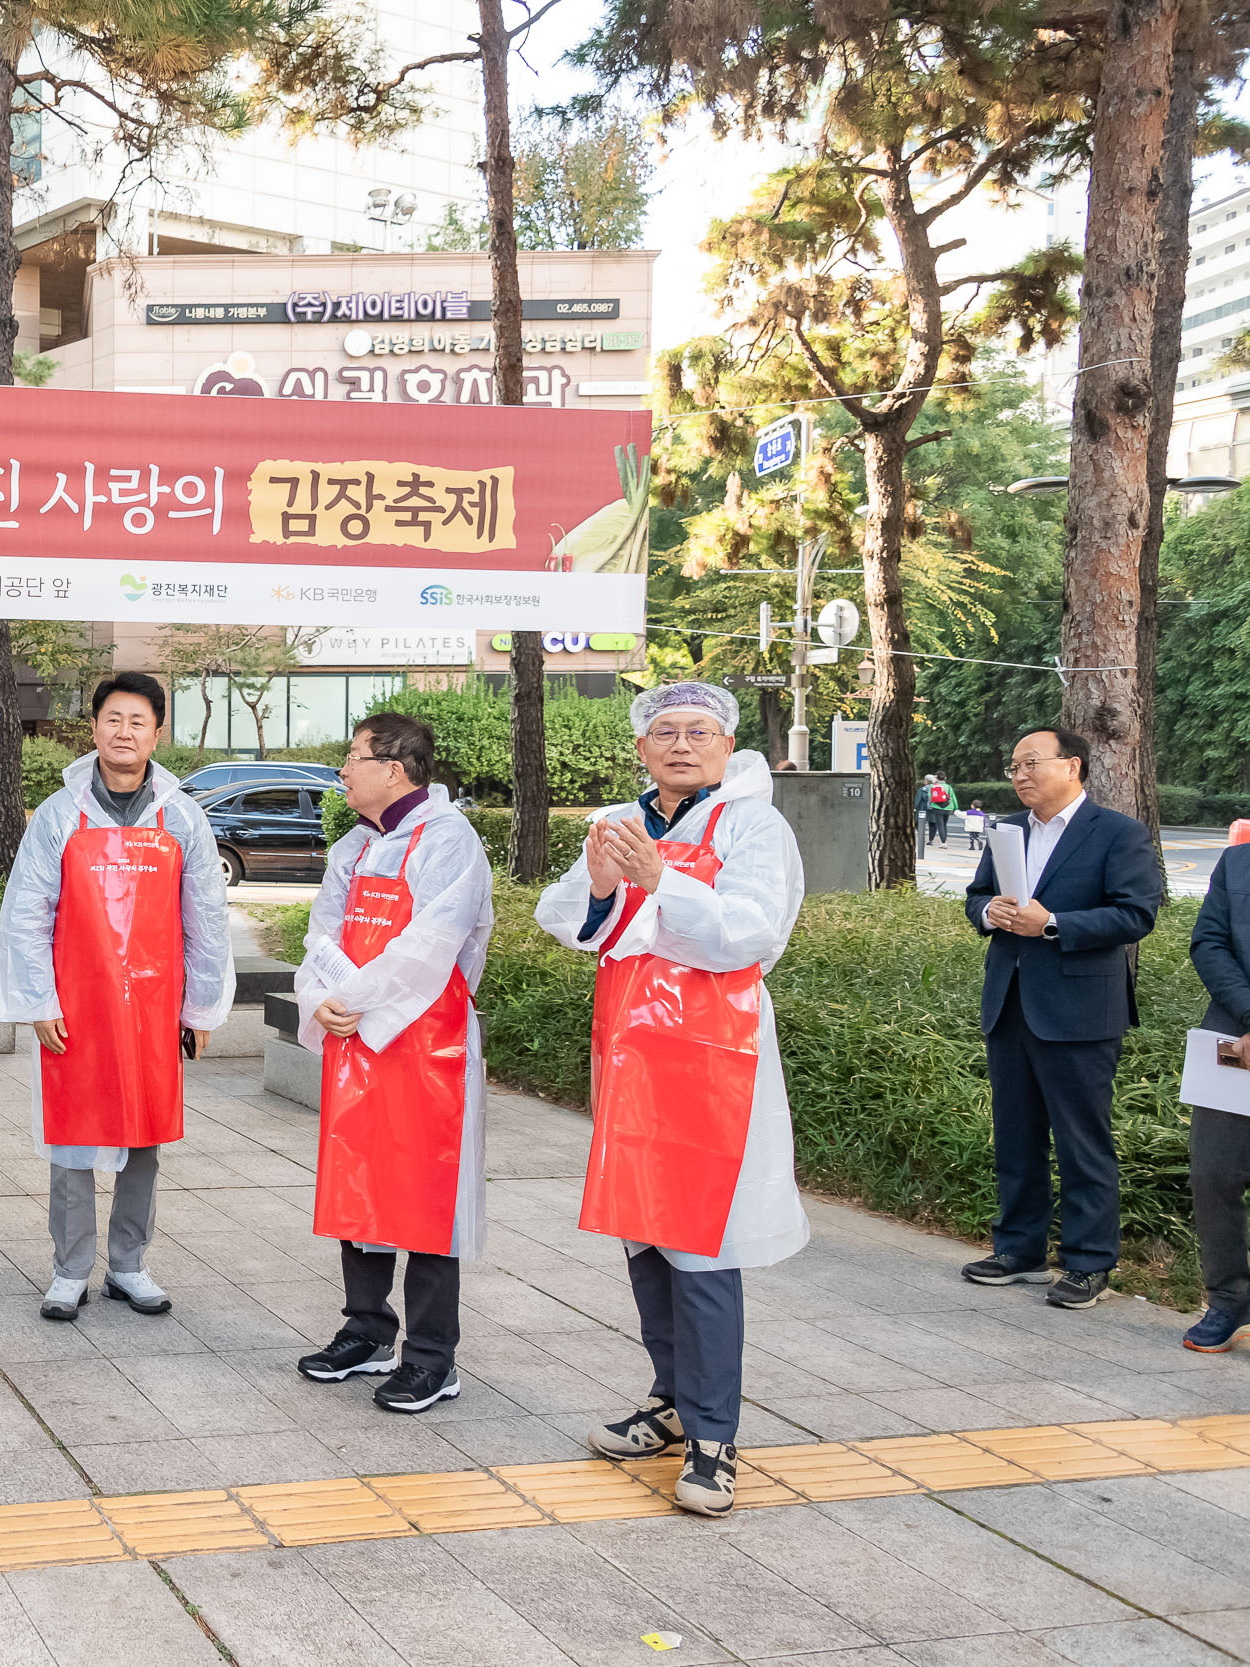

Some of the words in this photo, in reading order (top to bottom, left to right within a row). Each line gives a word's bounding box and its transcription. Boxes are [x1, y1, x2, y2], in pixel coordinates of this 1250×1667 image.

[286, 291, 470, 322] (주)제이테이블
[39, 461, 225, 536] 사랑의
[268, 469, 500, 543] 김장축제
[52, 577, 72, 599] 앞
[151, 583, 228, 598] 광진복지재단
[300, 587, 325, 601] KB
[327, 588, 377, 603] 국민은행
[455, 593, 541, 607] 한국사회보장정보원
[543, 631, 586, 653] CU
[850, 788, 861, 797] 10
